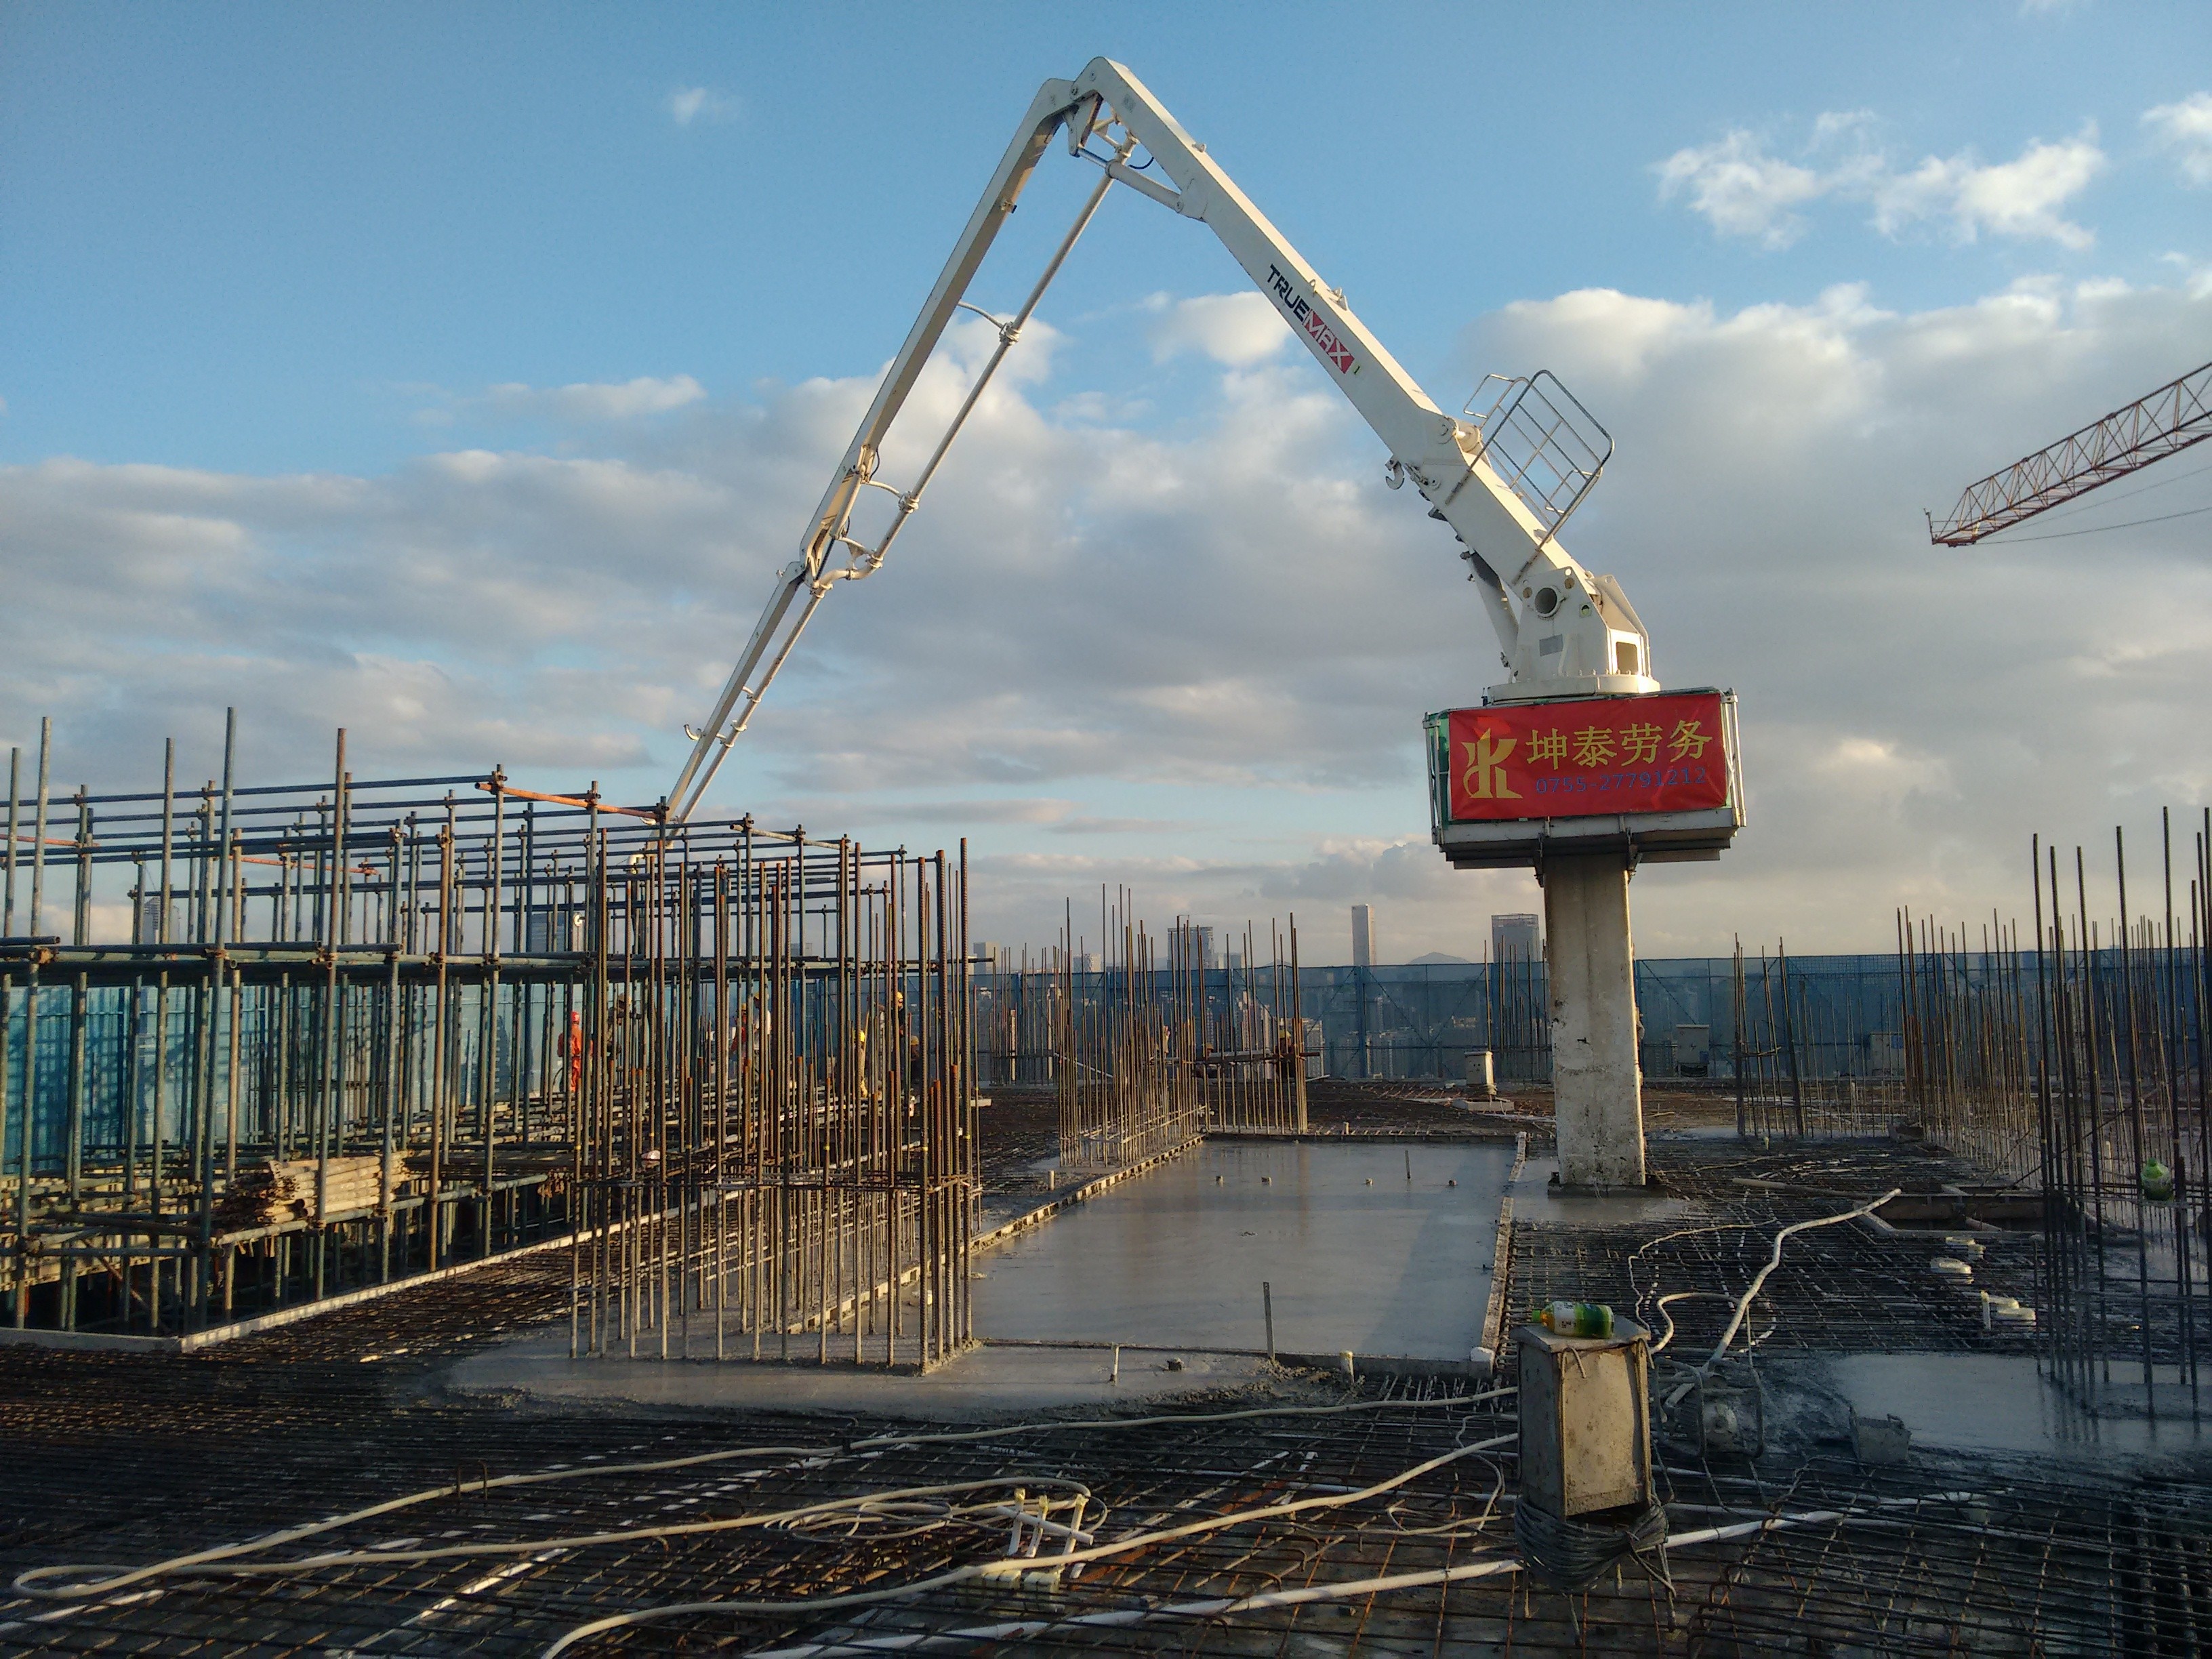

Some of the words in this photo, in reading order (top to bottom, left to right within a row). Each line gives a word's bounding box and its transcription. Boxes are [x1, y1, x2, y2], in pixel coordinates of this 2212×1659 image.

[1267, 263, 1355, 374] TRUEMAX
[1525, 719, 1713, 771] 坤泰劳务
[1535, 766, 1706, 794] 0755-27791212
